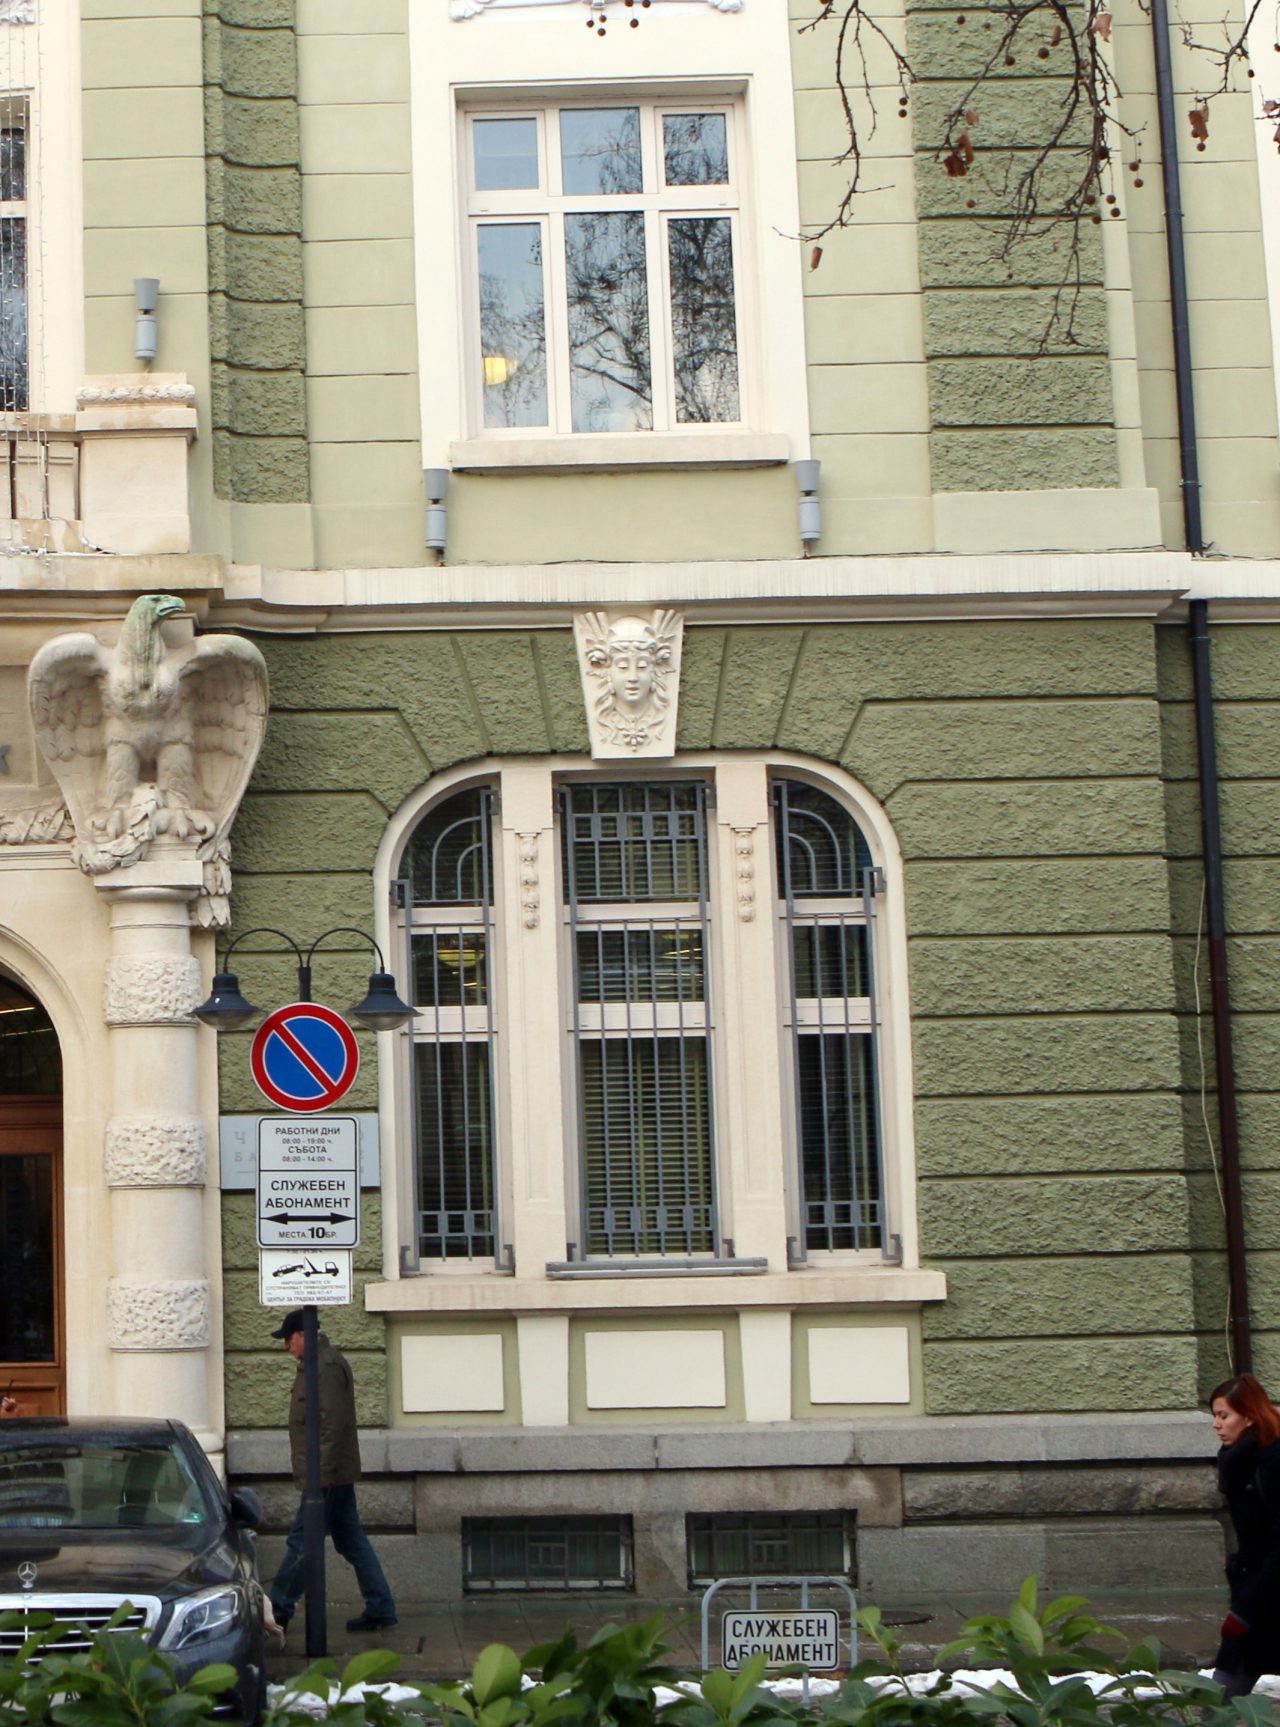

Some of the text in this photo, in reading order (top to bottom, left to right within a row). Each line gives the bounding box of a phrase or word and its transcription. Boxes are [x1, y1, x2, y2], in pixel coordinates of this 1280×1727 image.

[275, 1127, 341, 1136] РАБОТНИ ДНИ
[288, 1146, 327, 1154] СЪБОТА
[271, 1180, 346, 1191] СЛУЖЕБЕН
[265, 1198, 351, 1208] АБОНАМЕНТ
[732, 1619, 828, 1638] СЛУЖЕБЕН
